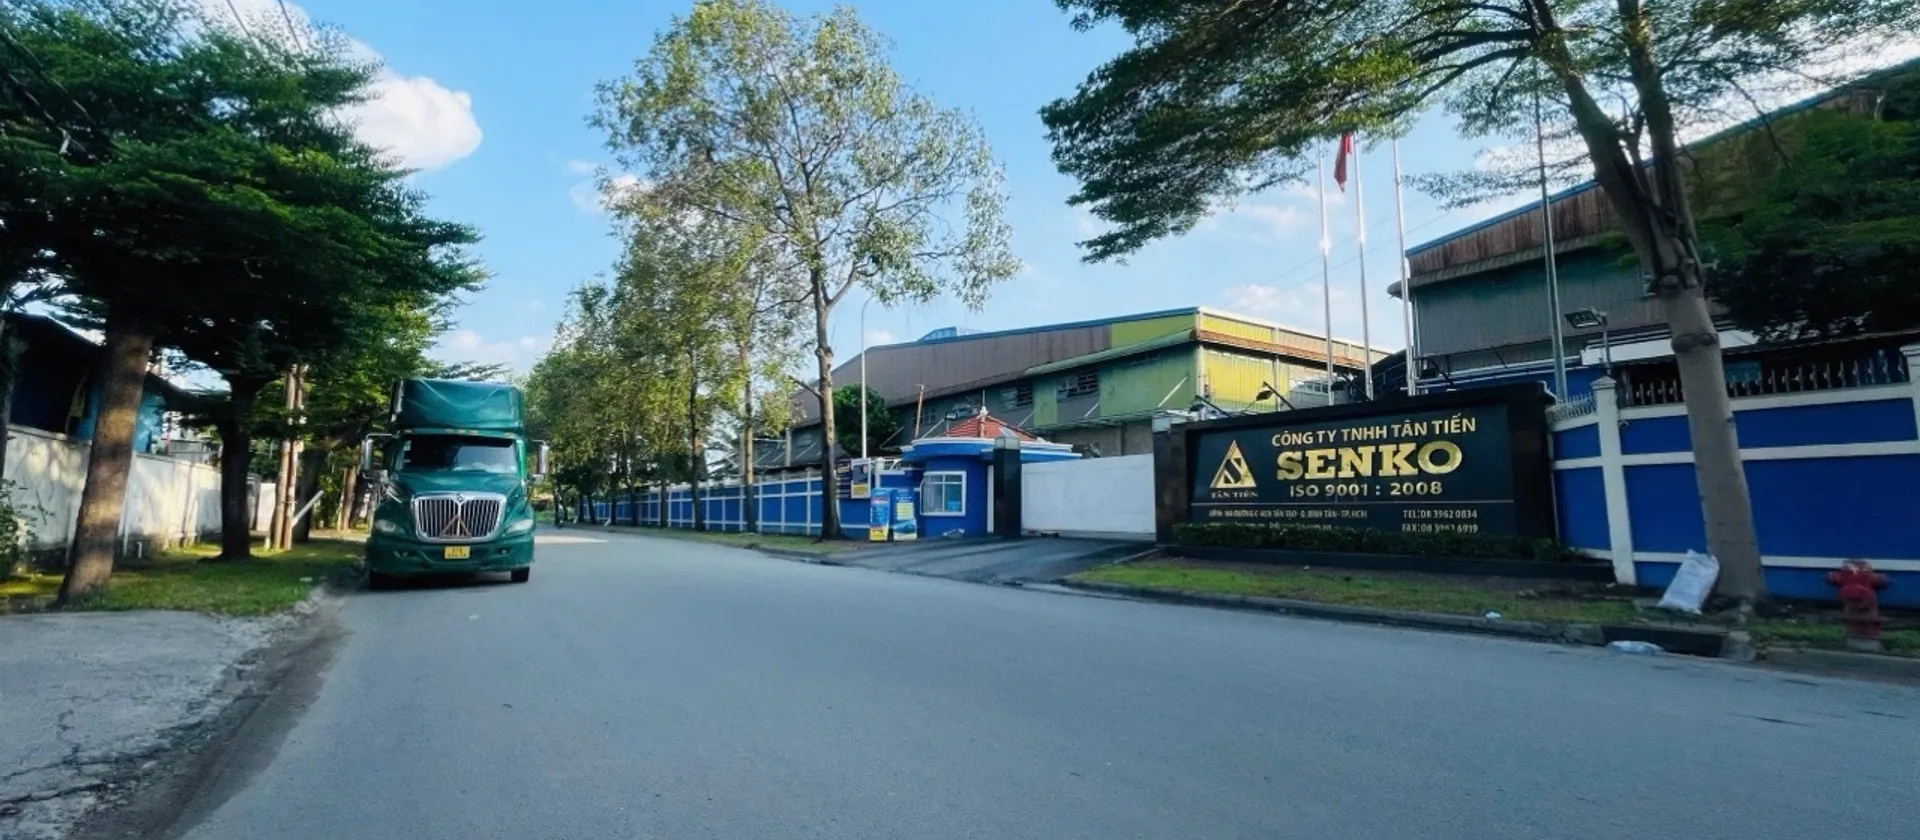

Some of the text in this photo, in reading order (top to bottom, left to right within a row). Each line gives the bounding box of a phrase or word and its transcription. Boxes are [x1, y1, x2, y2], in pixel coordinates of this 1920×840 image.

[1272, 412, 1476, 447] CÔNG TY TNHH TÂN TIẾN
[1276, 440, 1463, 481] SENKO
[1290, 484, 1319, 498] ISO
[1325, 483, 1368, 497] 9001
[1390, 481, 1443, 496] 2008
[1455, 509, 1478, 519] 0834
